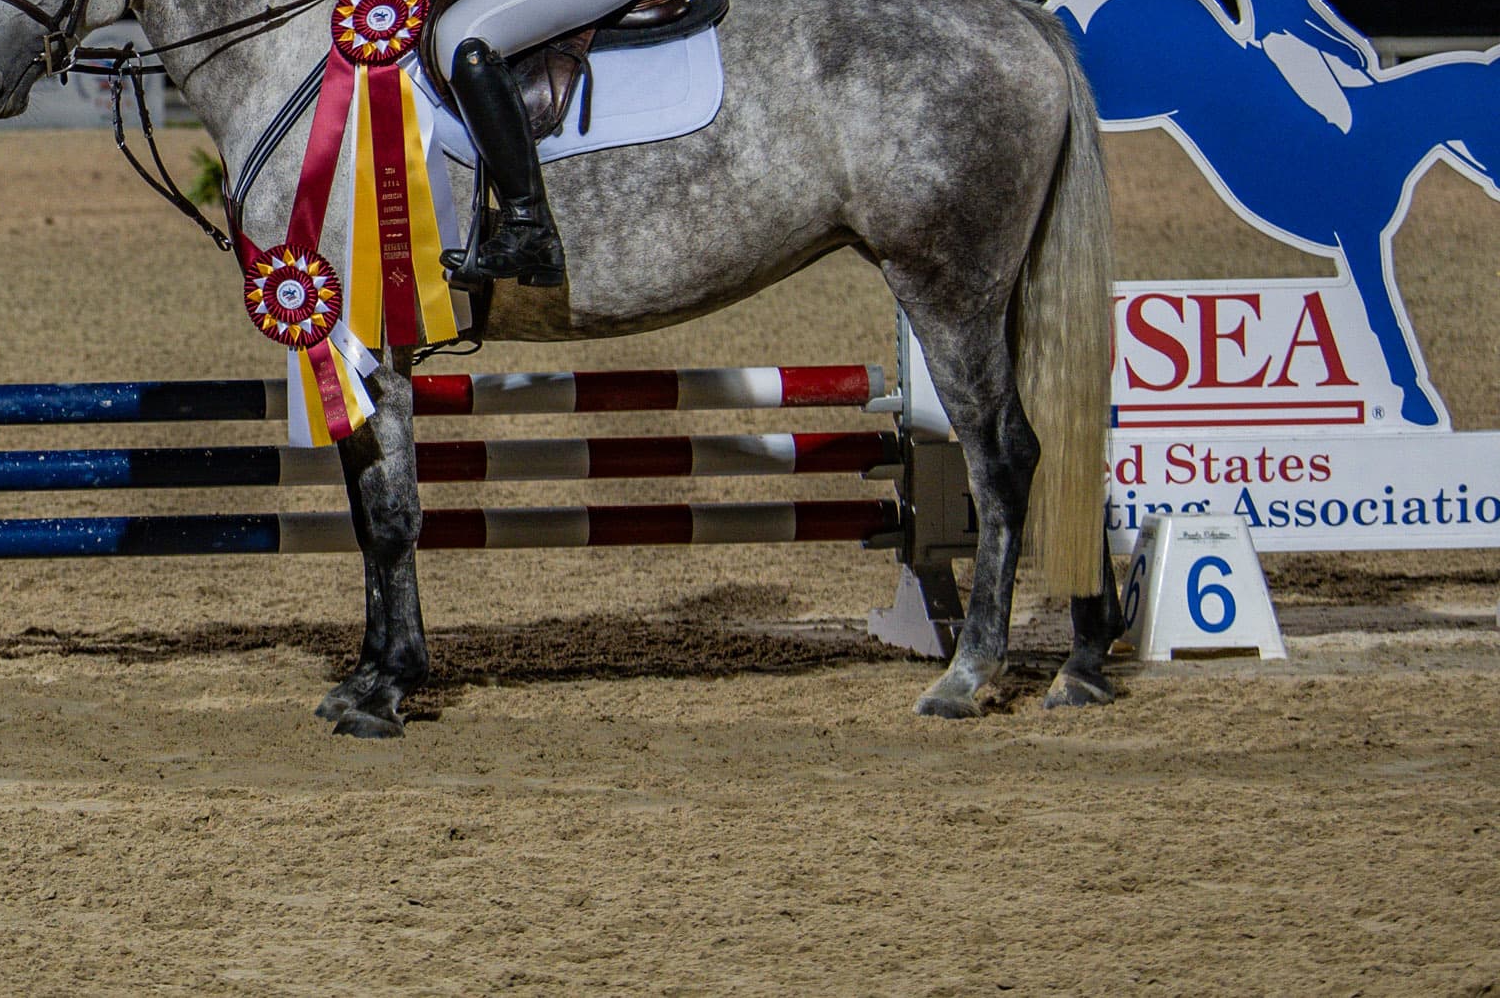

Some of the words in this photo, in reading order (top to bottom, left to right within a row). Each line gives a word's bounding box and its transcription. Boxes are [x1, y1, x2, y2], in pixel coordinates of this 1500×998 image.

[1110, 291, 1360, 392] SEA
[1165, 442, 1332, 485] States
[1186, 555, 1238, 634] 6
